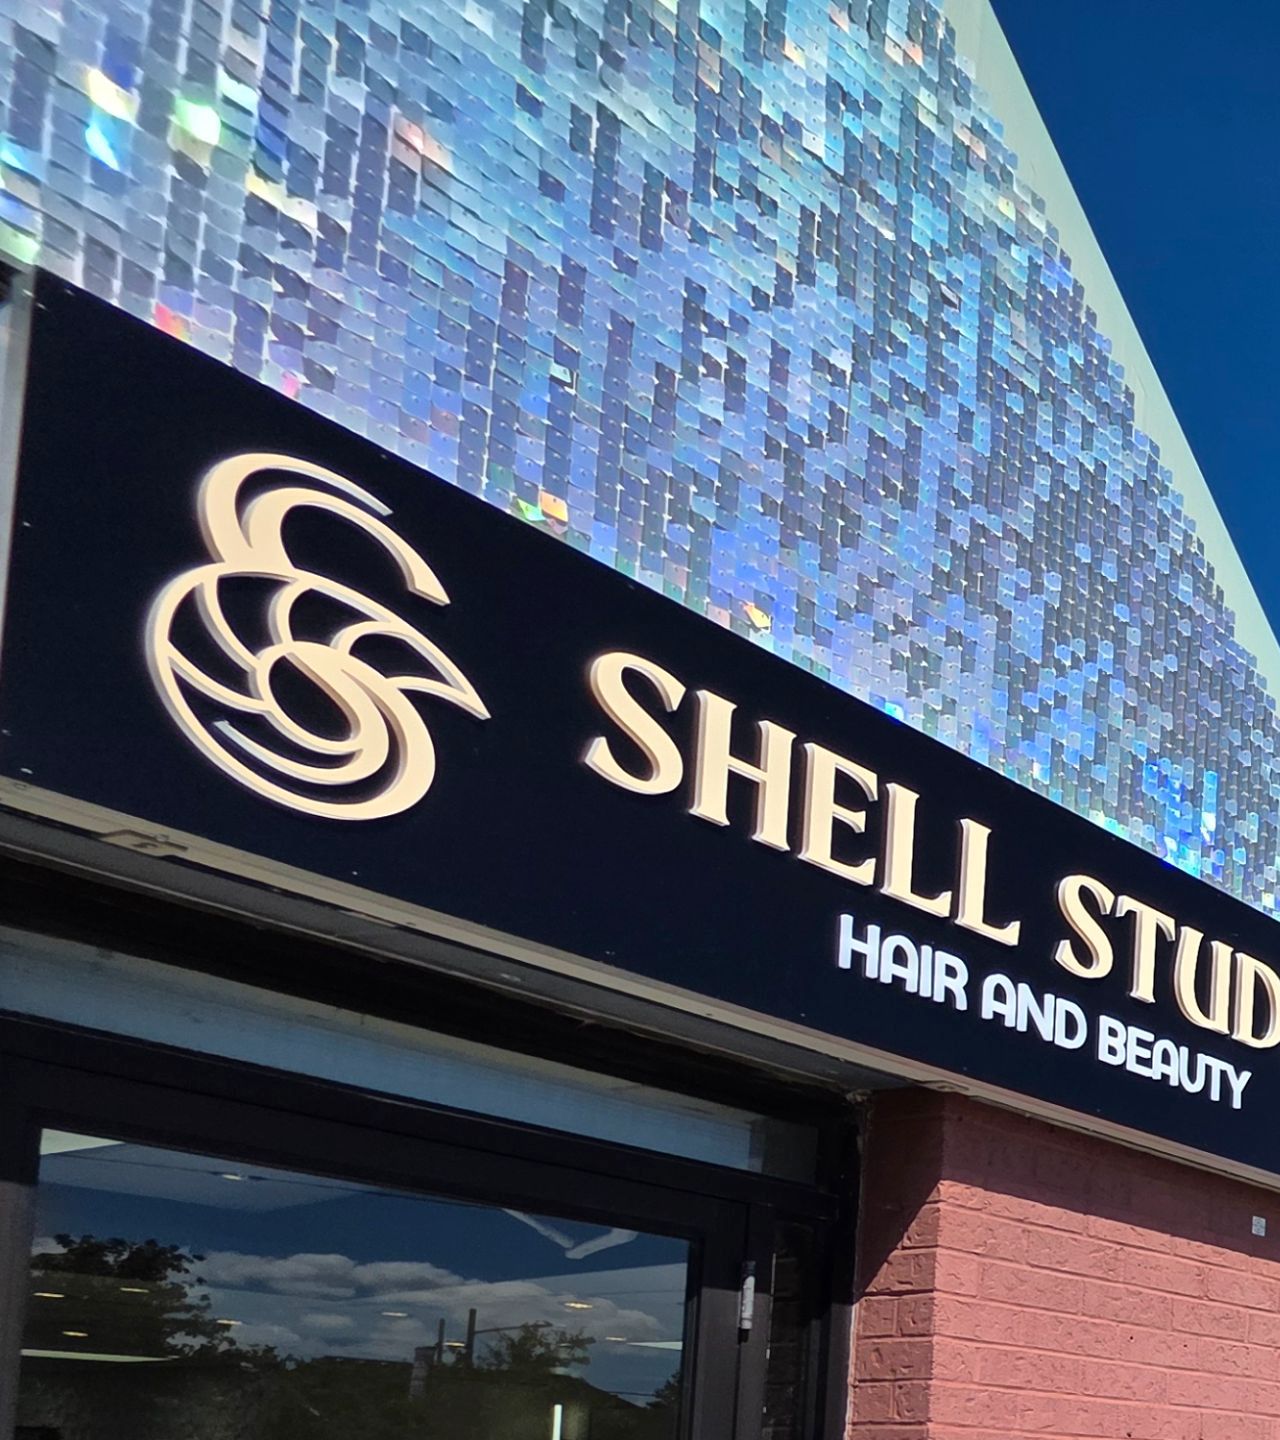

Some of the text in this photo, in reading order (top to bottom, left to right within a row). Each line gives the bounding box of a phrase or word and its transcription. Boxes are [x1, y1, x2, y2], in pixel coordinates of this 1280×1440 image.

[584, 650, 1021, 946] SHELL
[836, 914, 1252, 1110] HAIR AND BEAUTY
